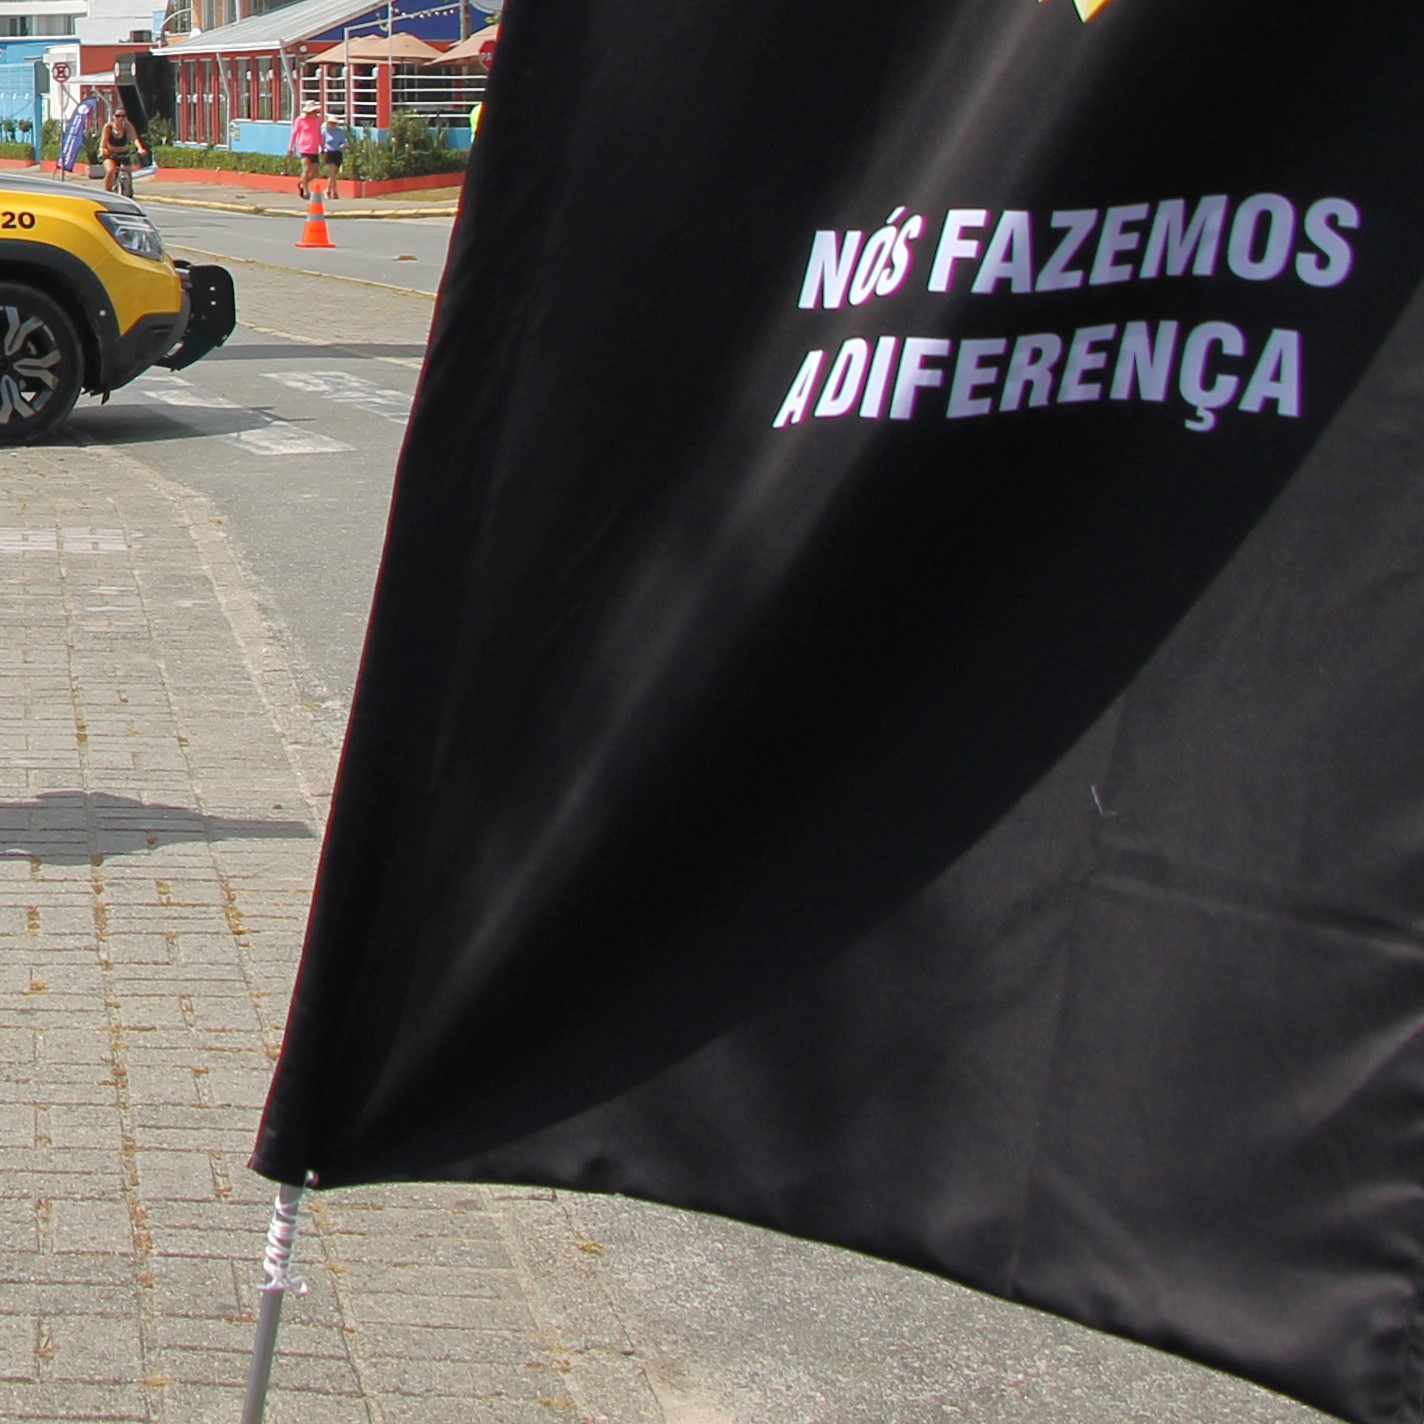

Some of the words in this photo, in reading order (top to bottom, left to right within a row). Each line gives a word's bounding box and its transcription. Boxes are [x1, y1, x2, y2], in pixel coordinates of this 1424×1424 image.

[798, 206, 924, 309] NÓS
[927, 193, 1361, 294] FAZEMOS
[772, 348, 826, 429] A
[813, 319, 1301, 432] DIFERENÇA
